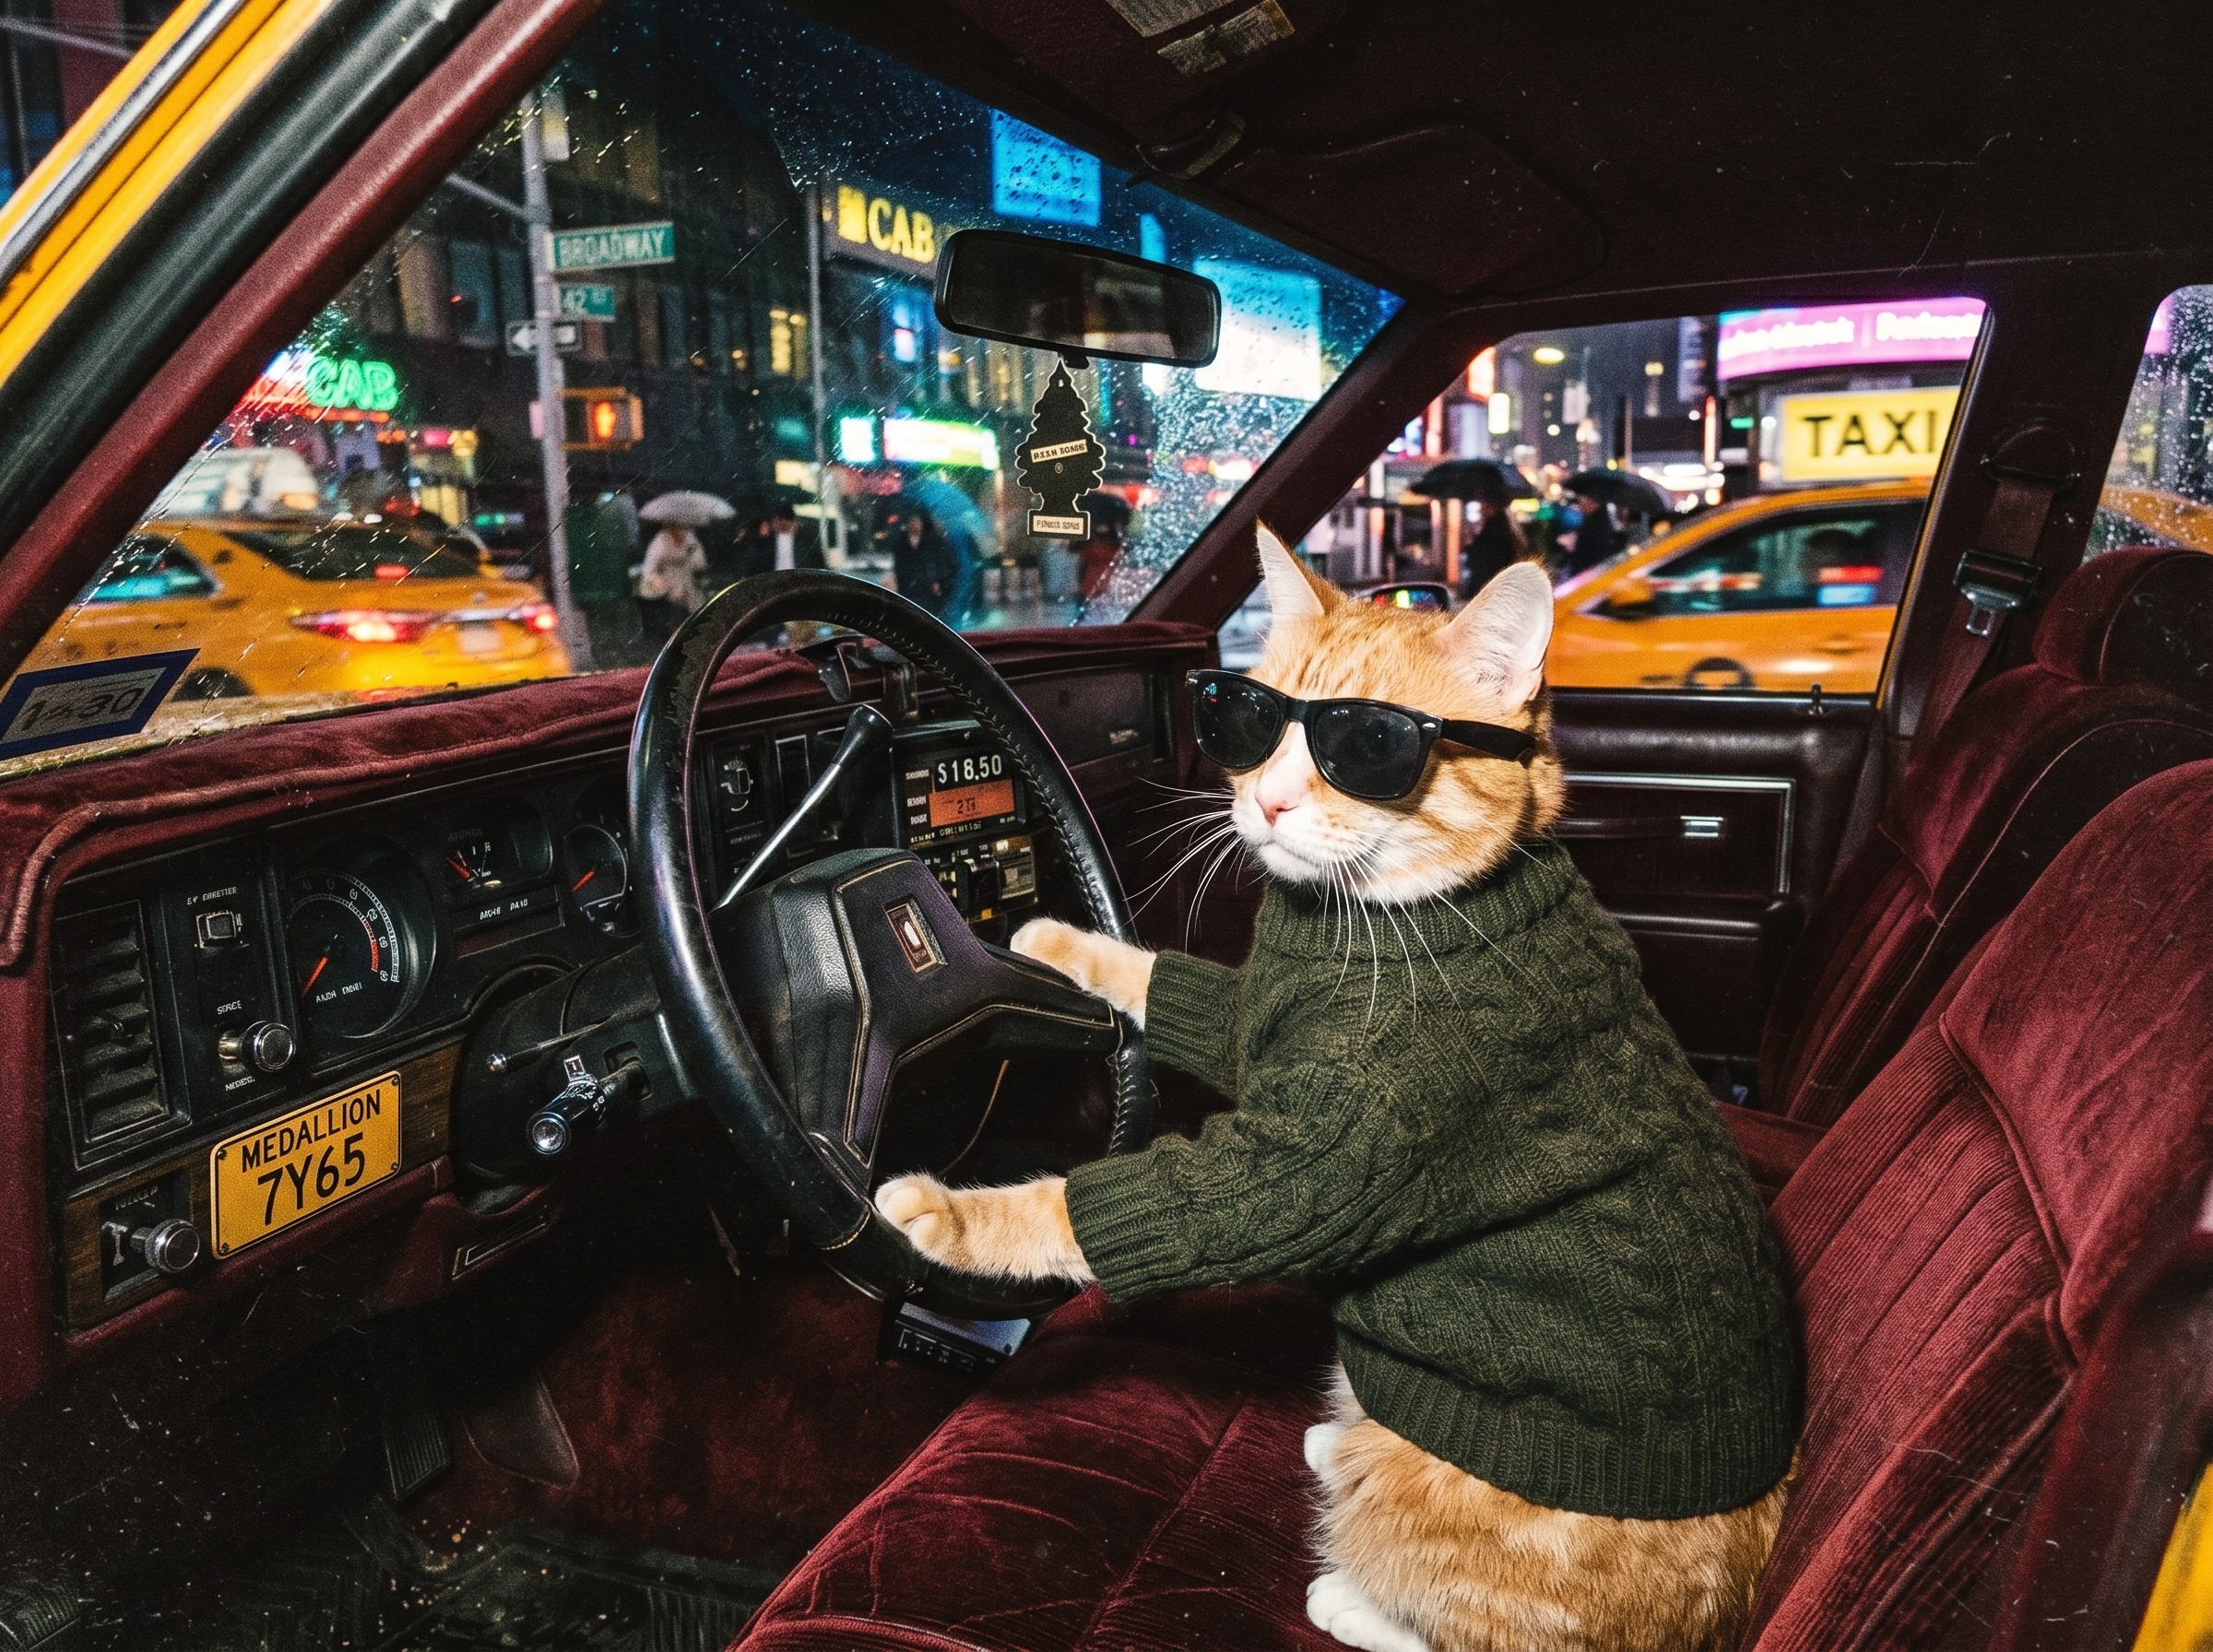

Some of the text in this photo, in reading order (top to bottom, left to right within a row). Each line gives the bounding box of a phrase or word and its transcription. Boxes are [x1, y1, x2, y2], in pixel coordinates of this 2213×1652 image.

[559, 230, 666, 267] BROADWAY
[868, 197, 935, 264] CAB
[306, 356, 399, 411] CAB
[1804, 409, 1939, 457] TAXI
[938, 754, 1002, 785] $18.50
[242, 1088, 381, 1174] MEDALLION
[257, 1131, 366, 1227] 7Y65
